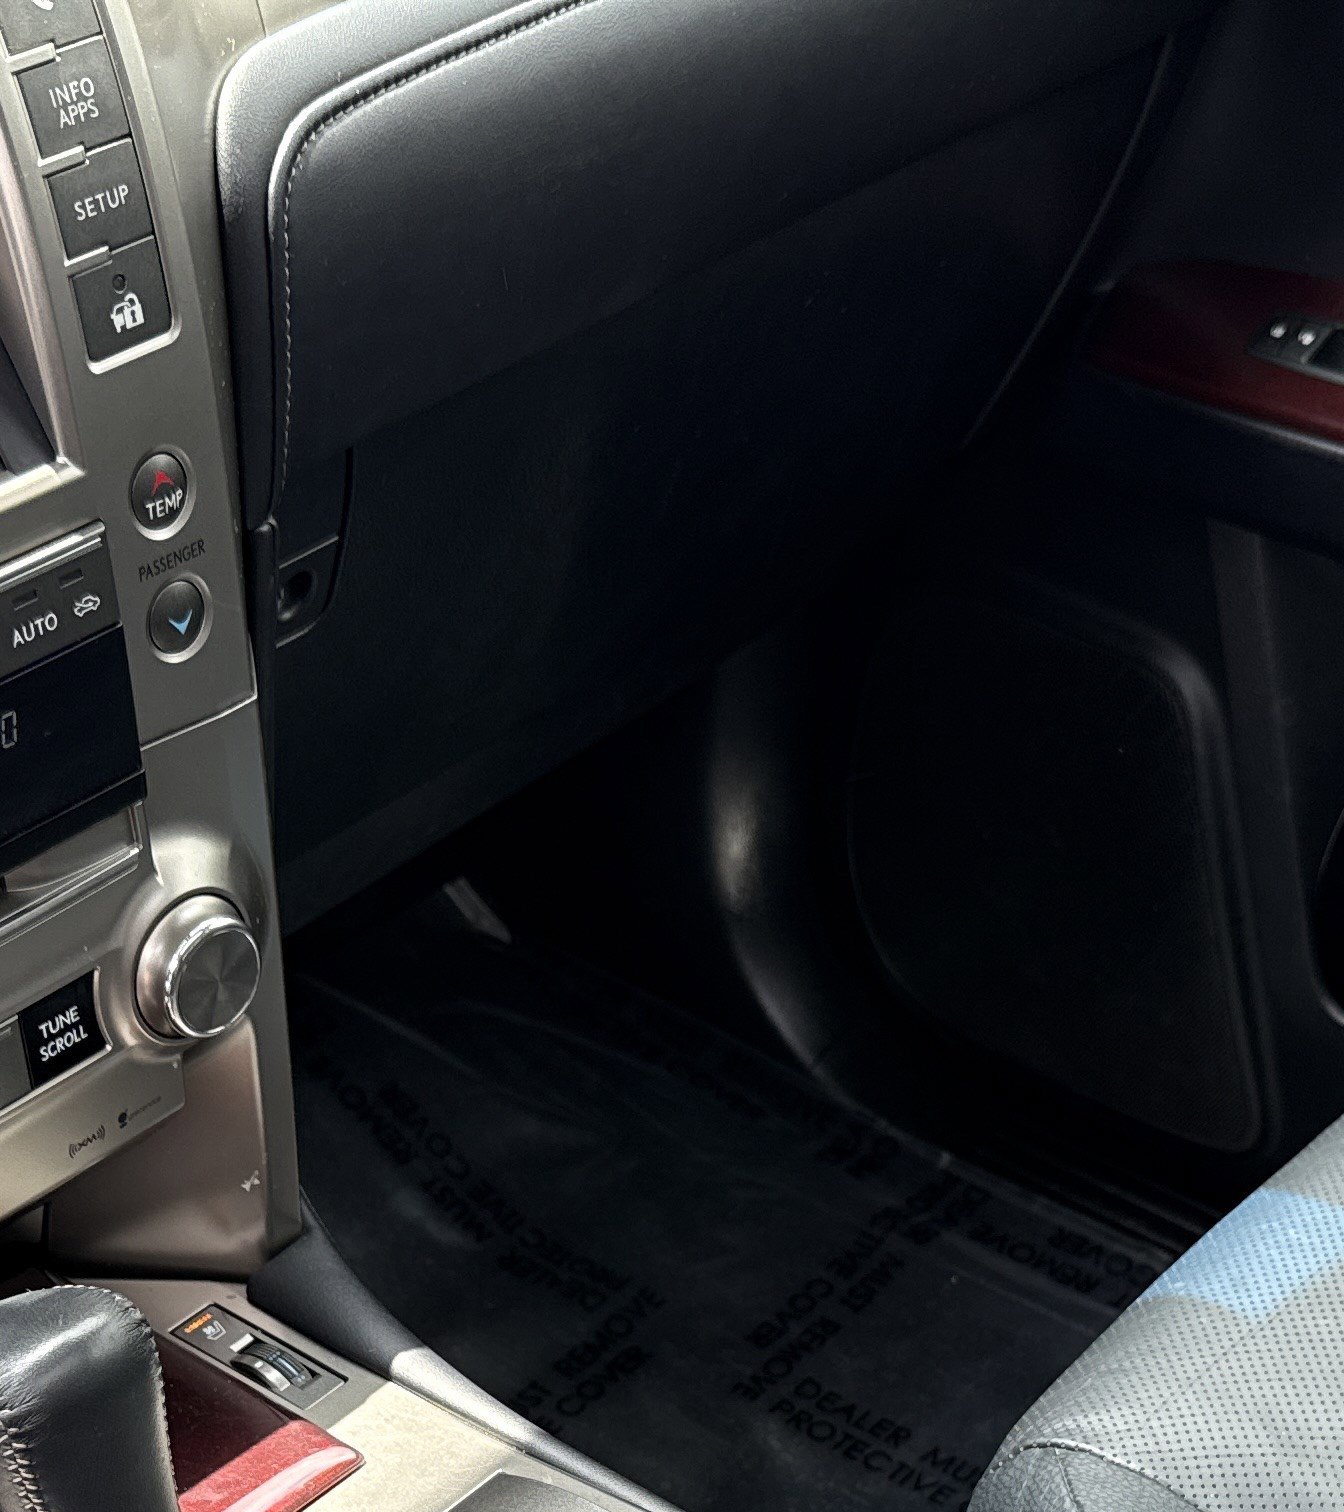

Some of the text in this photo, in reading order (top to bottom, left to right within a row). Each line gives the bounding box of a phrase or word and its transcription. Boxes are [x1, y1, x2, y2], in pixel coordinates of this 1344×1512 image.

[48, 77, 95, 108] INFO
[58, 101, 99, 130] APPS
[74, 184, 130, 221] SETUP
[145, 489, 184, 520] TEMP
[137, 538, 206, 583] PASSENGER
[12, 613, 60, 649] AUTO
[38, 1005, 80, 1039] TUNE
[39, 1025, 89, 1061] SCROLL
[793, 1377, 984, 1485] DEALER MU
[769, 1399, 958, 1506] PROTECTIVE
